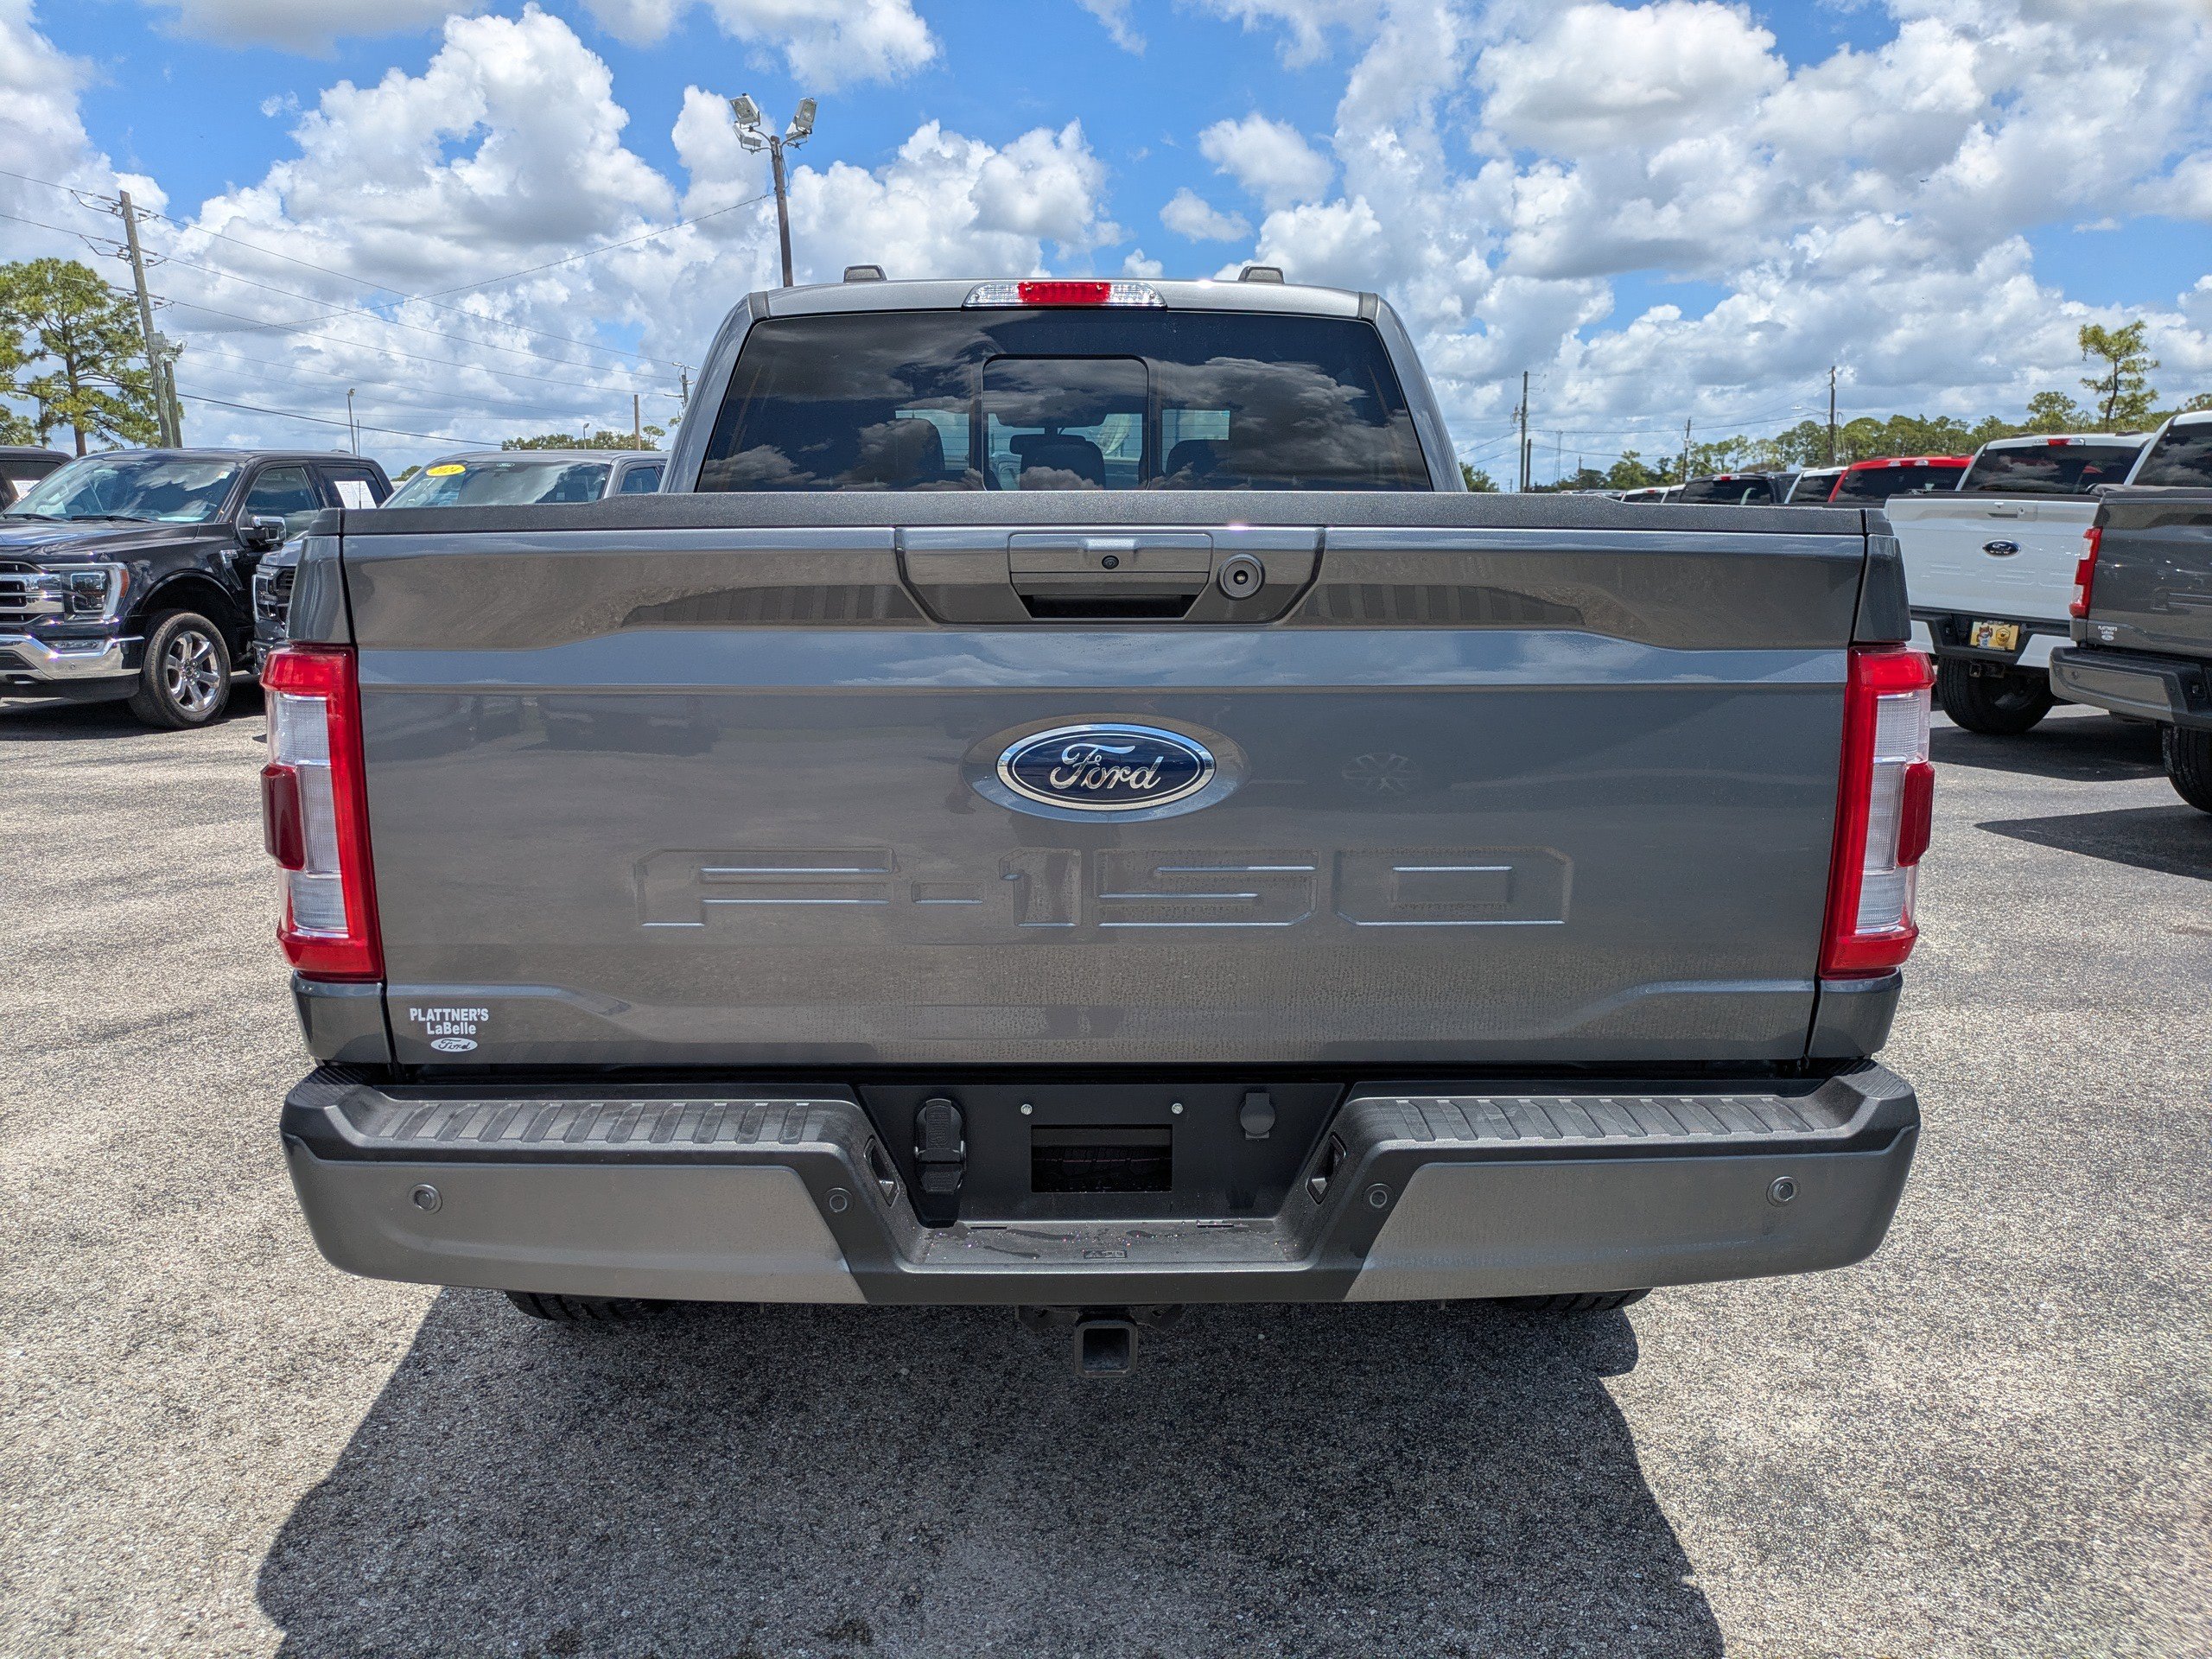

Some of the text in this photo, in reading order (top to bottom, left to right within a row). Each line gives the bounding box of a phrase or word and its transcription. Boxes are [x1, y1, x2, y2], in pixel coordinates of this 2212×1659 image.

[1049, 743, 1161, 790] Ford
[640, 847, 1573, 928] F-150
[410, 1007, 489, 1021] PLATTNER'S
[426, 1021, 476, 1034] LaBelle
[438, 1039, 471, 1050] Ford
